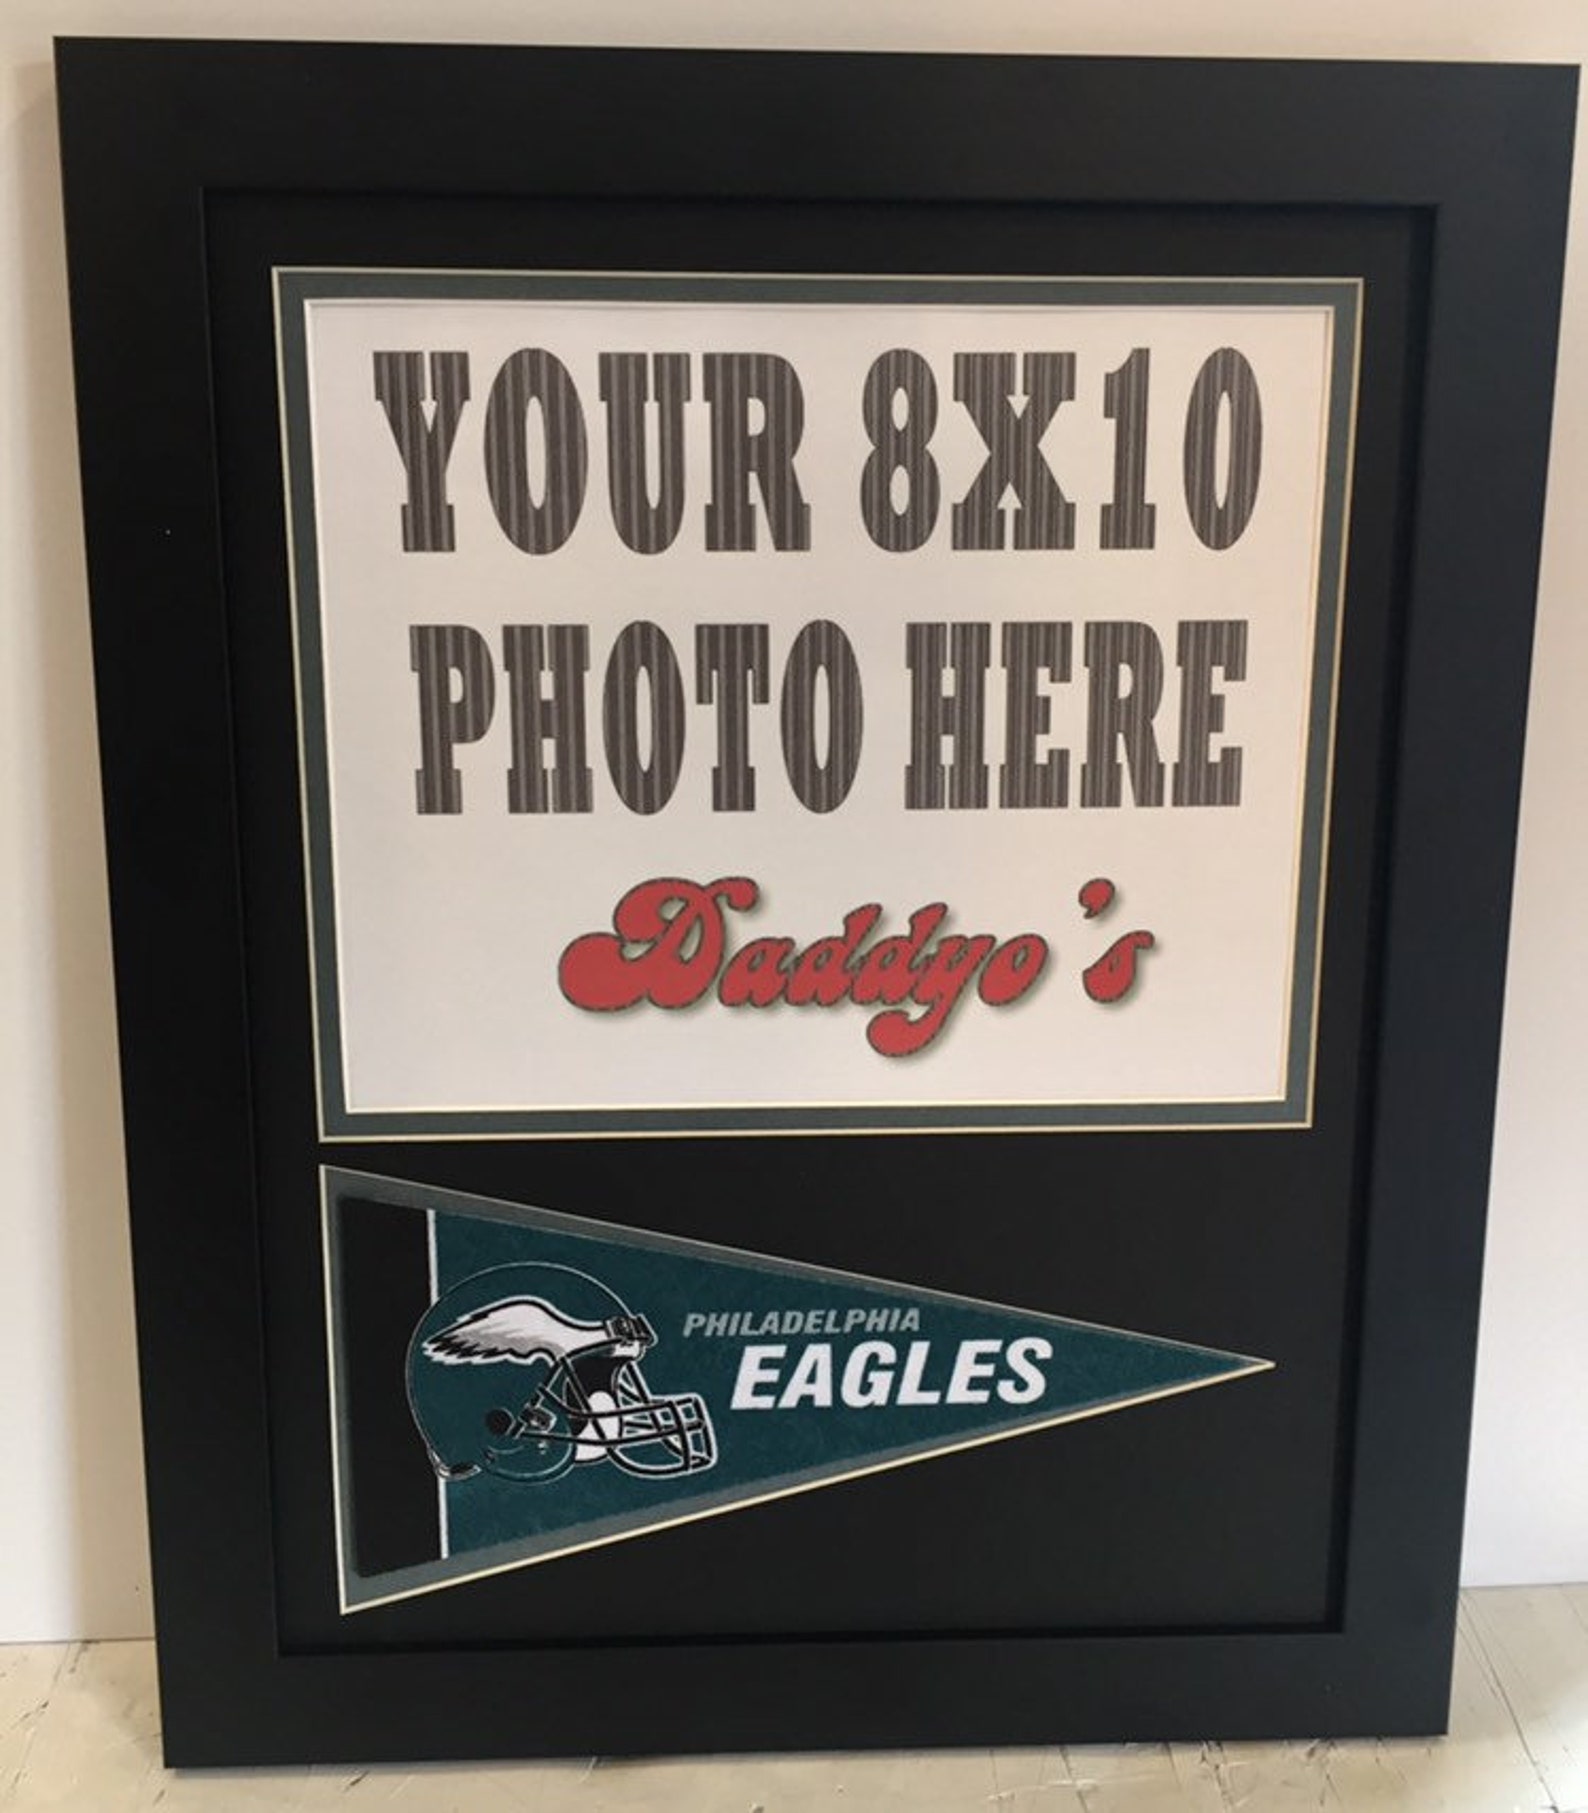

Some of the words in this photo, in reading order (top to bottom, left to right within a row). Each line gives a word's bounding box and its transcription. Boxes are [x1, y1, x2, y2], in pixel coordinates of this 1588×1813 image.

[373, 347, 811, 555] YOUR
[860, 347, 1262, 552] 8X10
[410, 619, 864, 815] PHOTO
[905, 620, 1248, 809] HERE
[683, 1308, 920, 1338] PHILADELPHIA
[730, 1337, 1053, 1410] EAGLES
